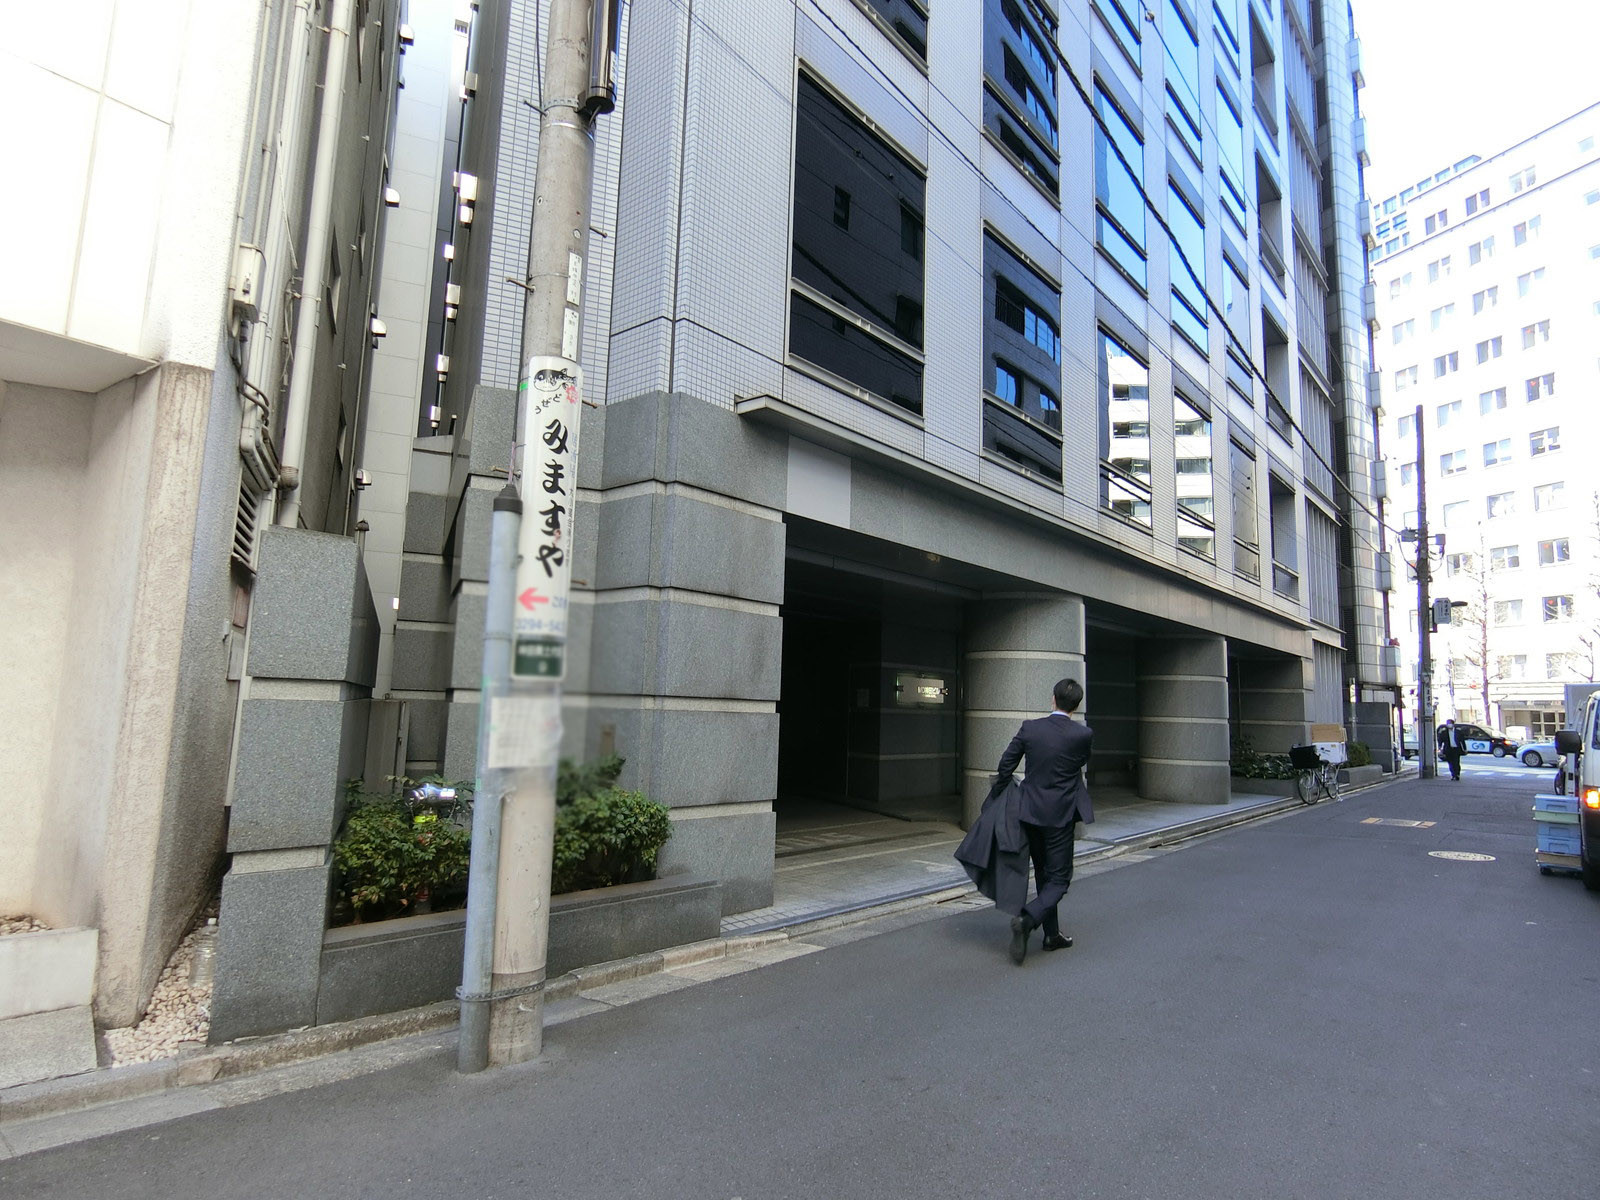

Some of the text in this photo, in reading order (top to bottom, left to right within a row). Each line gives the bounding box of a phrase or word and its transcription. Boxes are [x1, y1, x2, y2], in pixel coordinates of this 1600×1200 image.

[536, 418, 569, 578] みますや
[1471, 742, 1486, 750] GO
